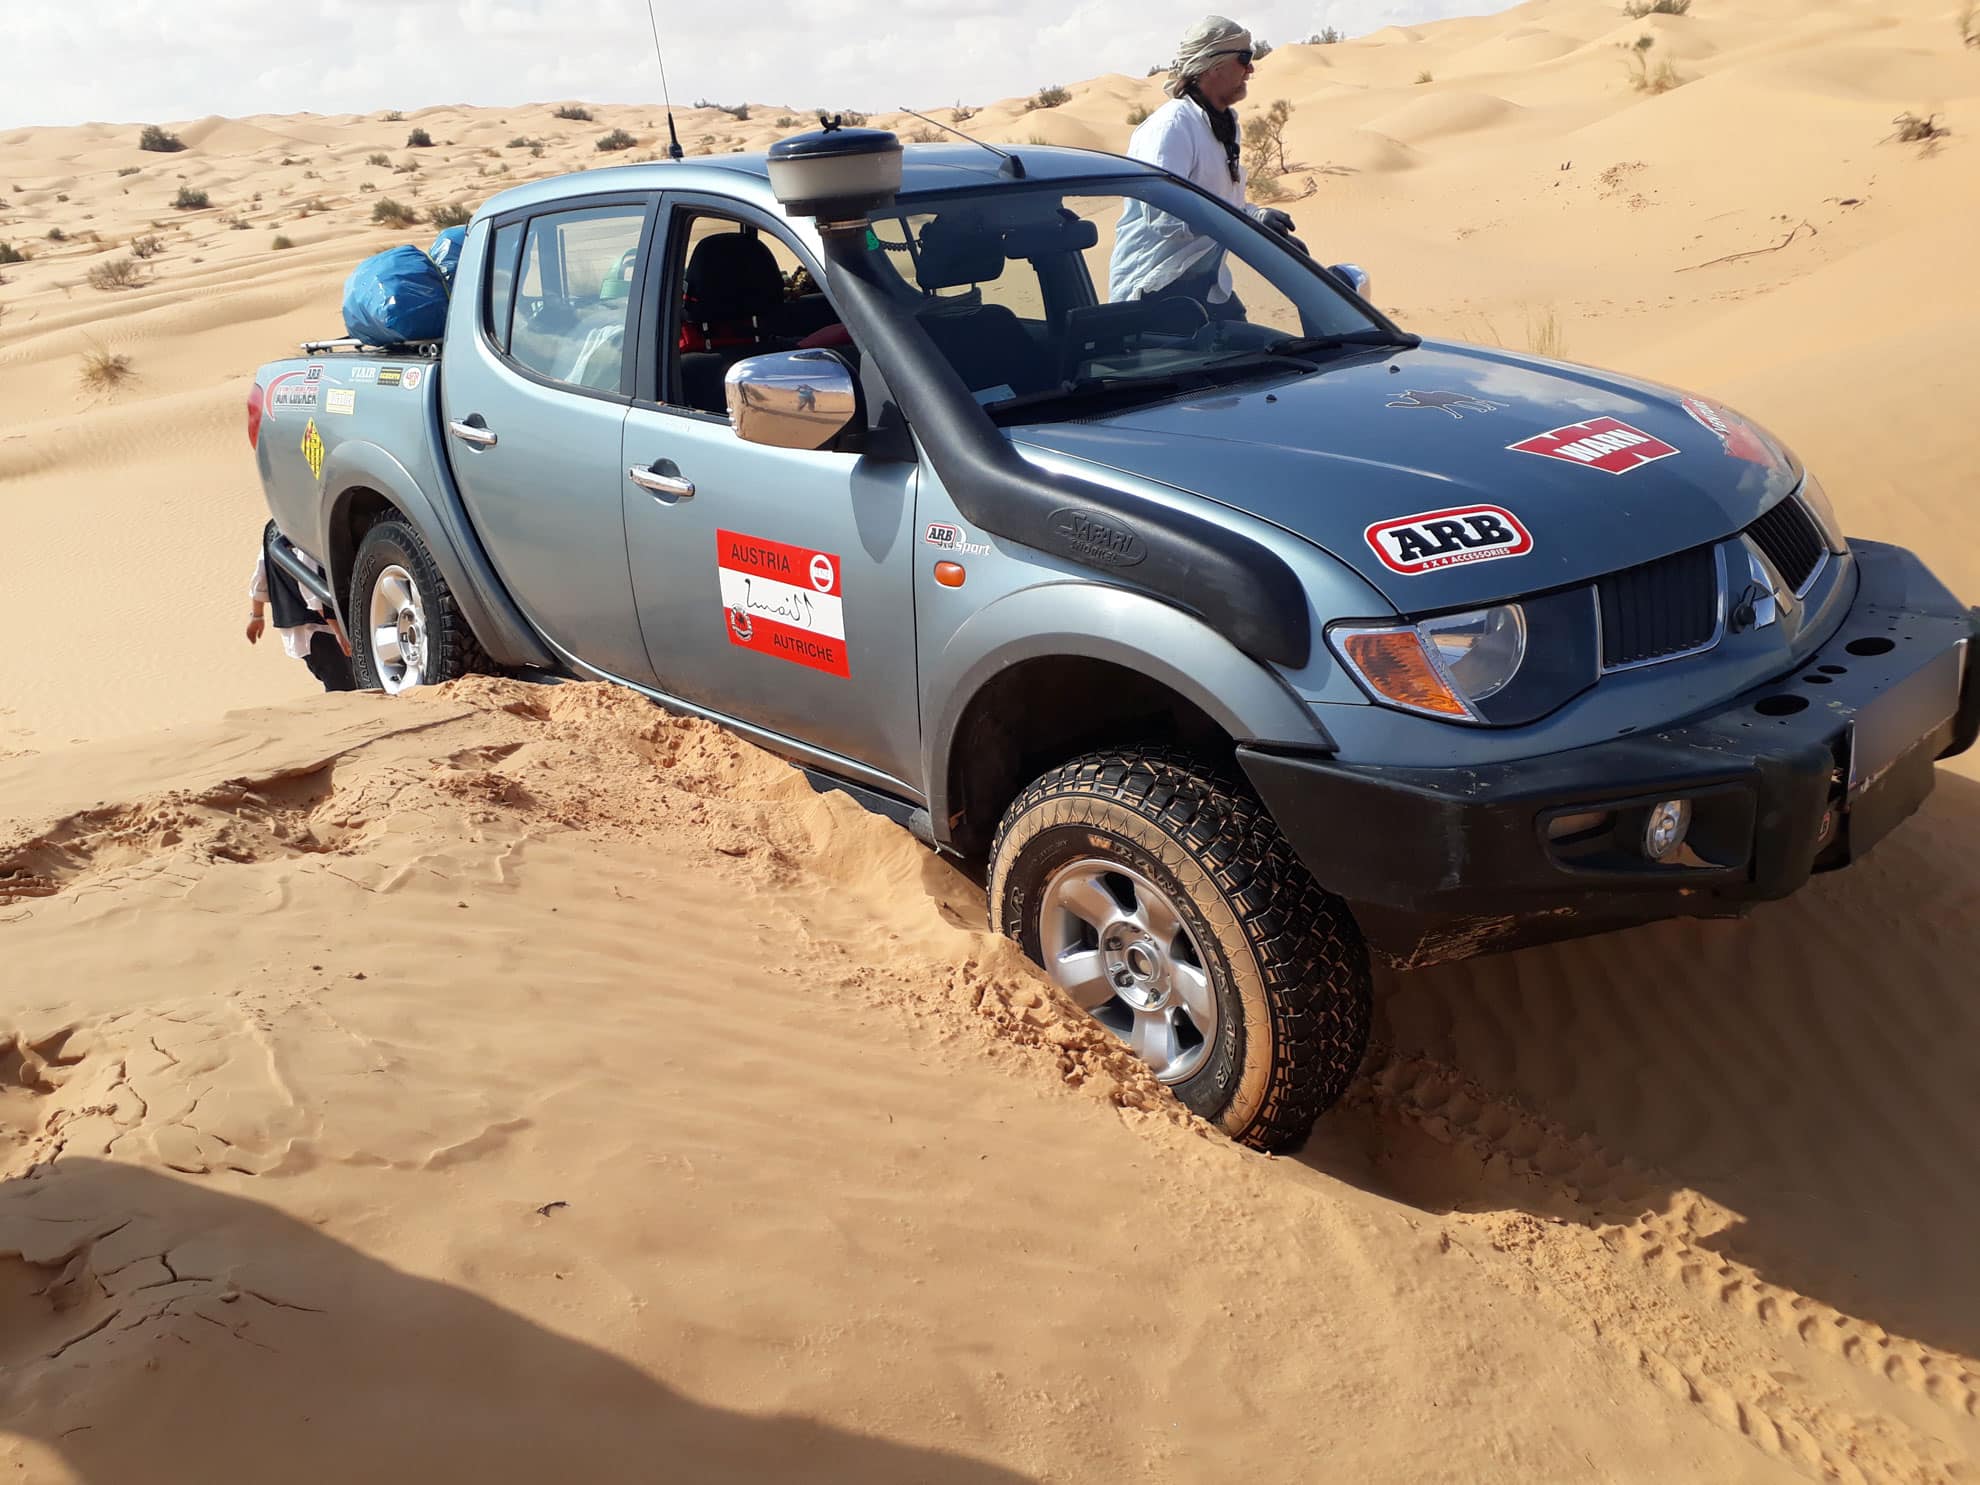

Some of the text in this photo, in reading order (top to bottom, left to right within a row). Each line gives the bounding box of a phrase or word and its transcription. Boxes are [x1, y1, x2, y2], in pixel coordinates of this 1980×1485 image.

[1552, 429, 1651, 462] WARN
[928, 527, 953, 542] ARB
[1070, 511, 1135, 553] SAFARI
[1389, 515, 1514, 562] ARB
[731, 543, 791, 573] AUSTRIA
[955, 542, 991, 557] sport
[1451, 547, 1511, 563] ACCESSORIES
[774, 633, 834, 663] AUTRICHE
